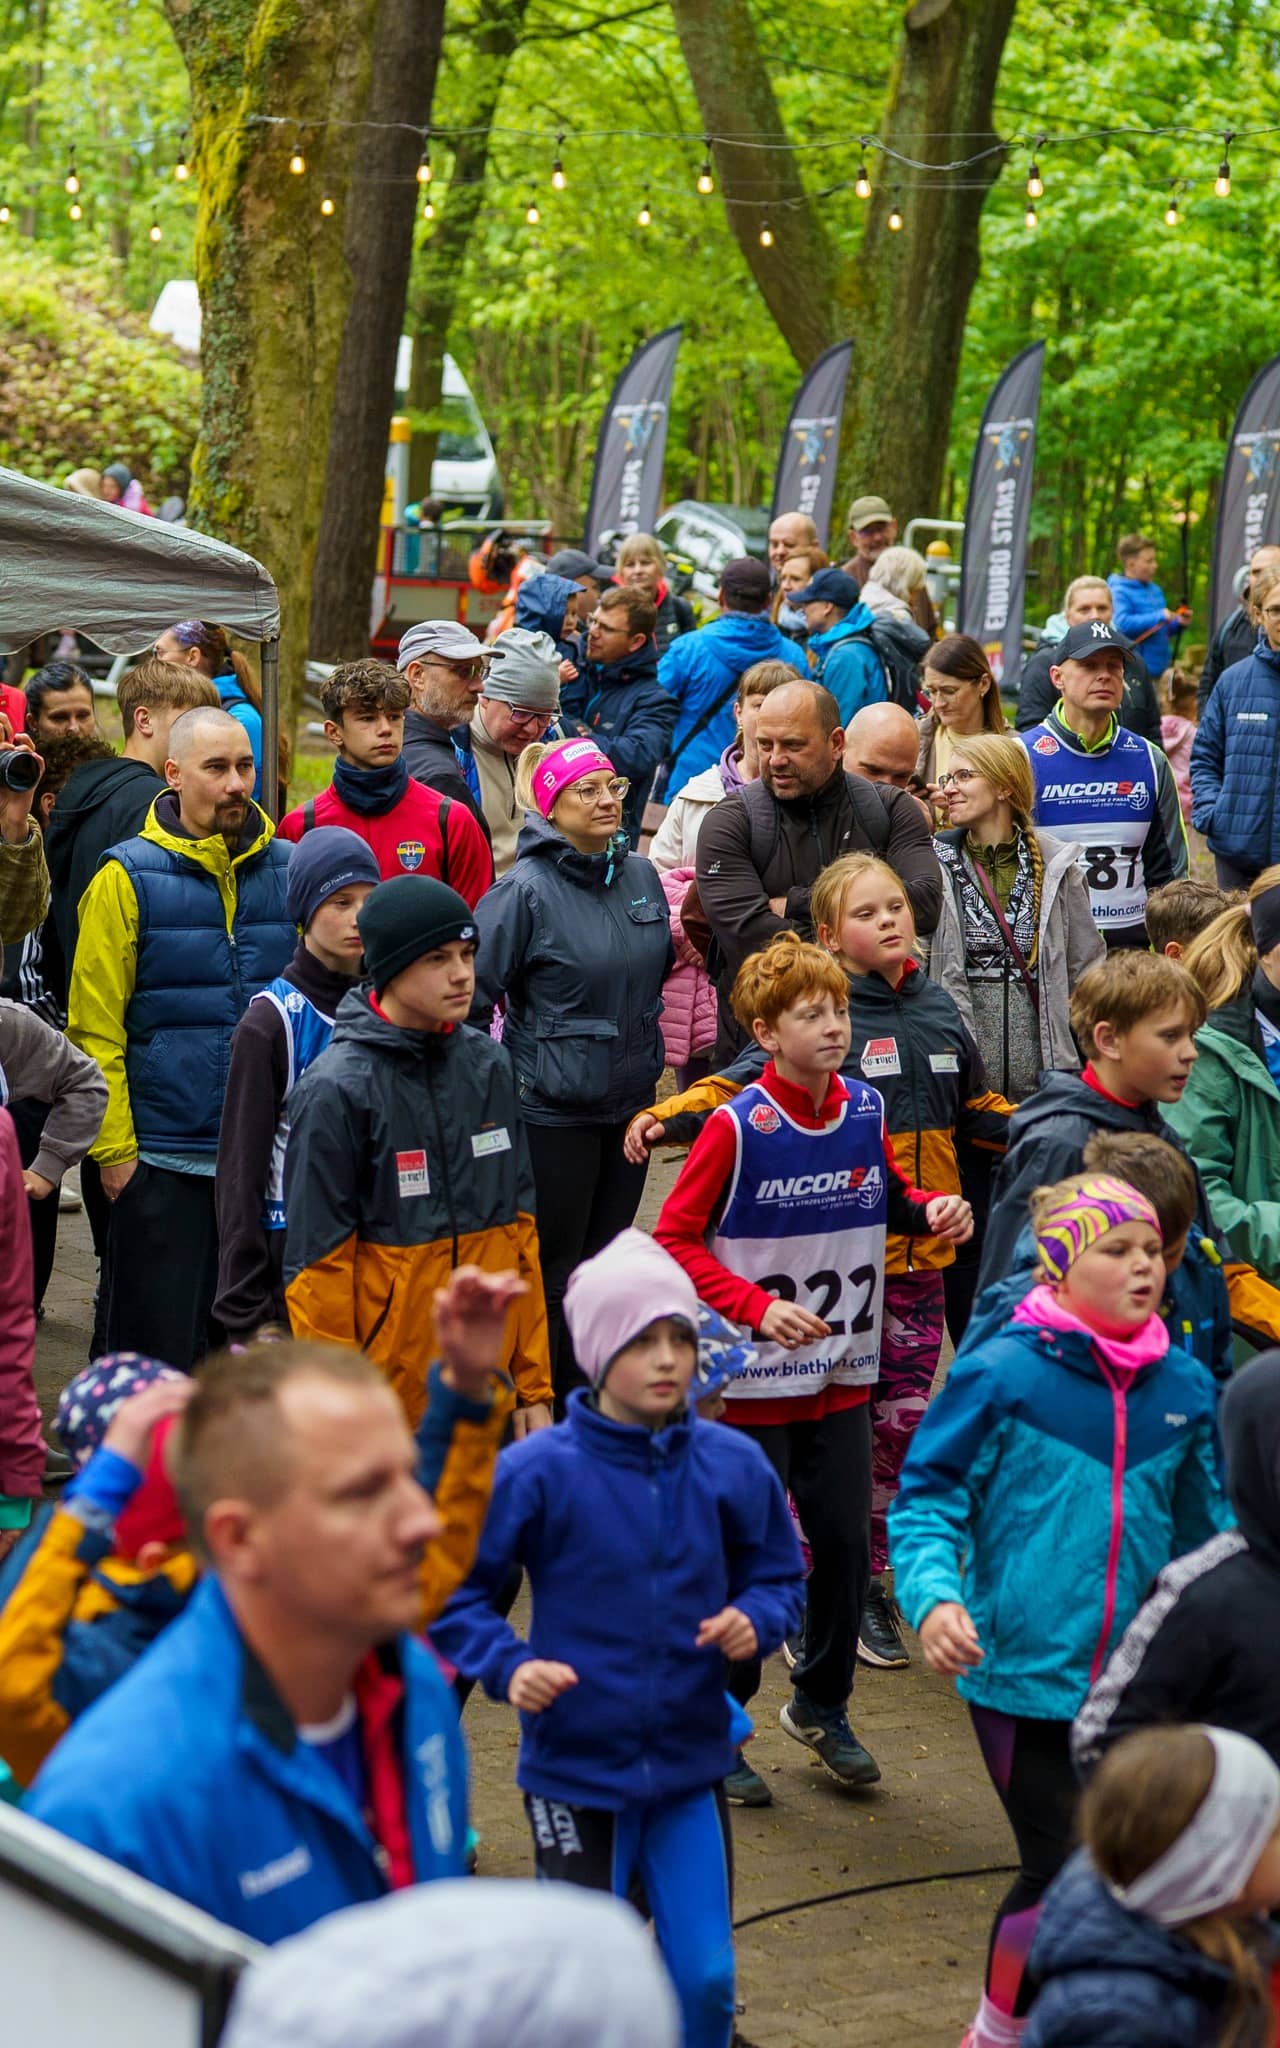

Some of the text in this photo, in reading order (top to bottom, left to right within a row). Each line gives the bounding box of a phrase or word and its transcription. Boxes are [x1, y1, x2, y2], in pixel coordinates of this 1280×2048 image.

[798, 475, 821, 514] ARS
[984, 478, 1016, 632] ENDURO STARS
[1041, 781, 1146, 799] INCORSA
[1085, 846, 1141, 890] 87
[756, 1165, 880, 1199] INCORSA
